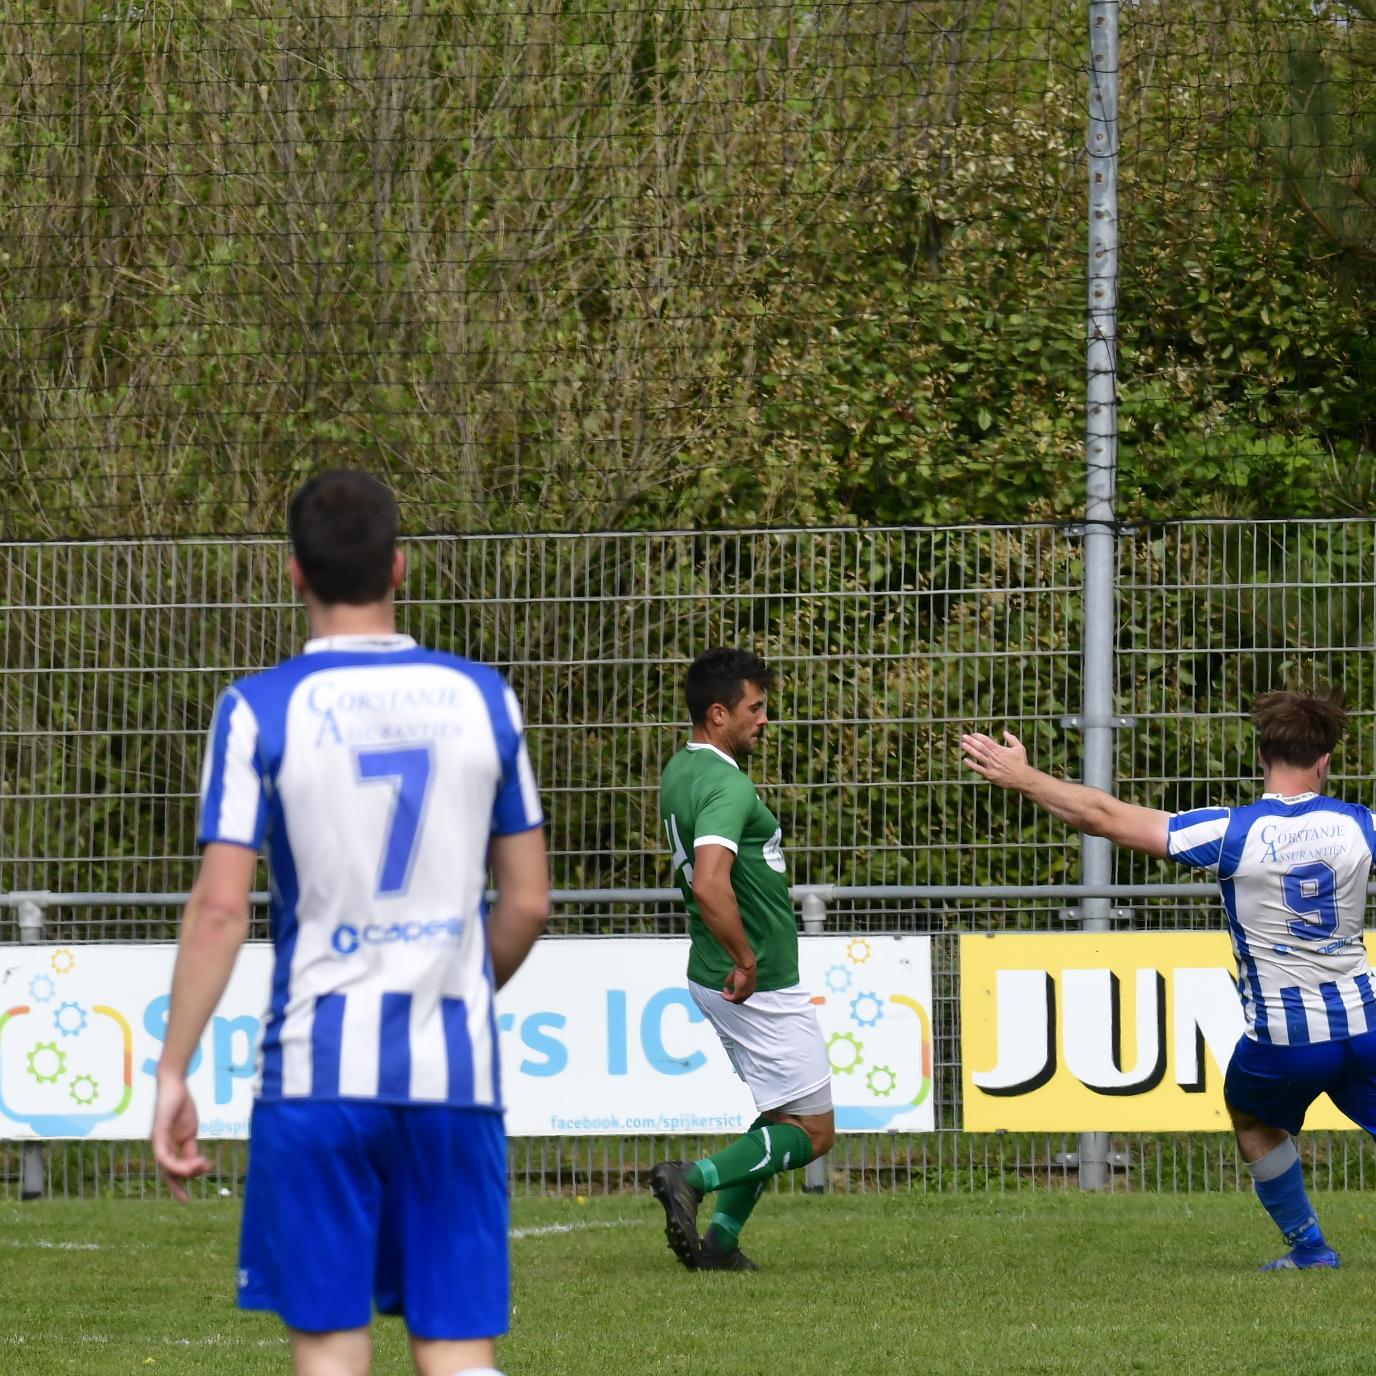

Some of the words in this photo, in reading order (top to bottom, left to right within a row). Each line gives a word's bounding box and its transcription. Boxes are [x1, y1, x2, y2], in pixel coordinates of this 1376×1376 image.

[350, 742, 437, 899] 7
[1261, 824, 1346, 845] CORSTANJE
[1279, 860, 1341, 941] 9
[551, 1114, 742, 1132] facebook.com/spijkersict
